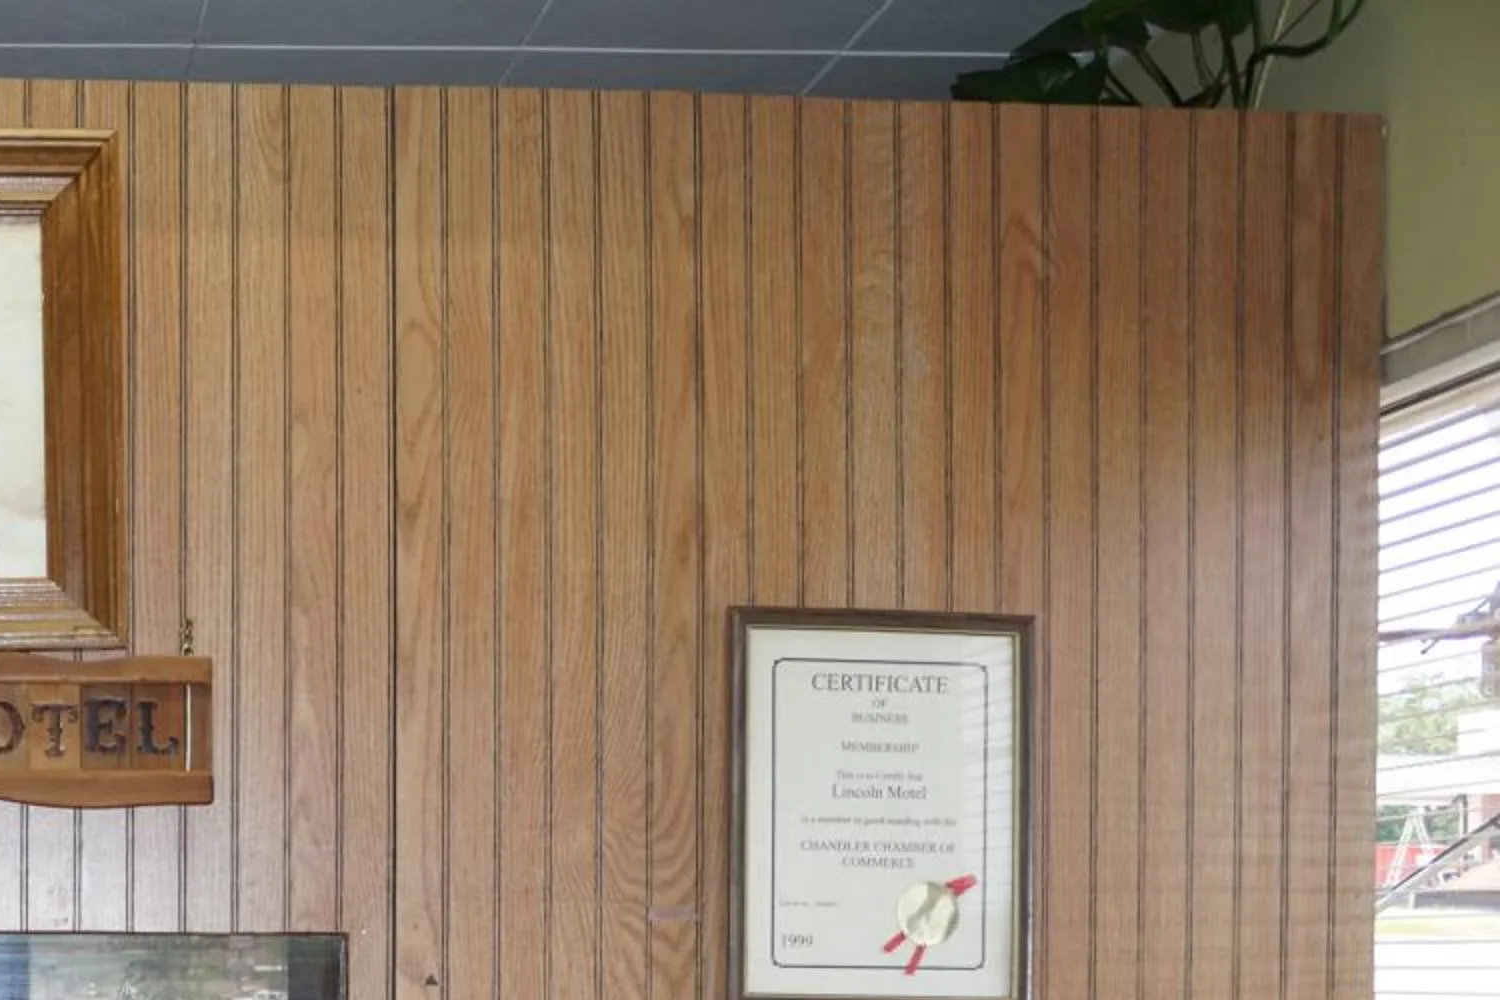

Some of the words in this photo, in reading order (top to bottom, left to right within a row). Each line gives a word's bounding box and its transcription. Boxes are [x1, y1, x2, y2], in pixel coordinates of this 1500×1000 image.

[811, 672, 950, 694] CERTIFICATE
[831, 783, 883, 799] Lincoln
[887, 785, 928, 800] Motel
